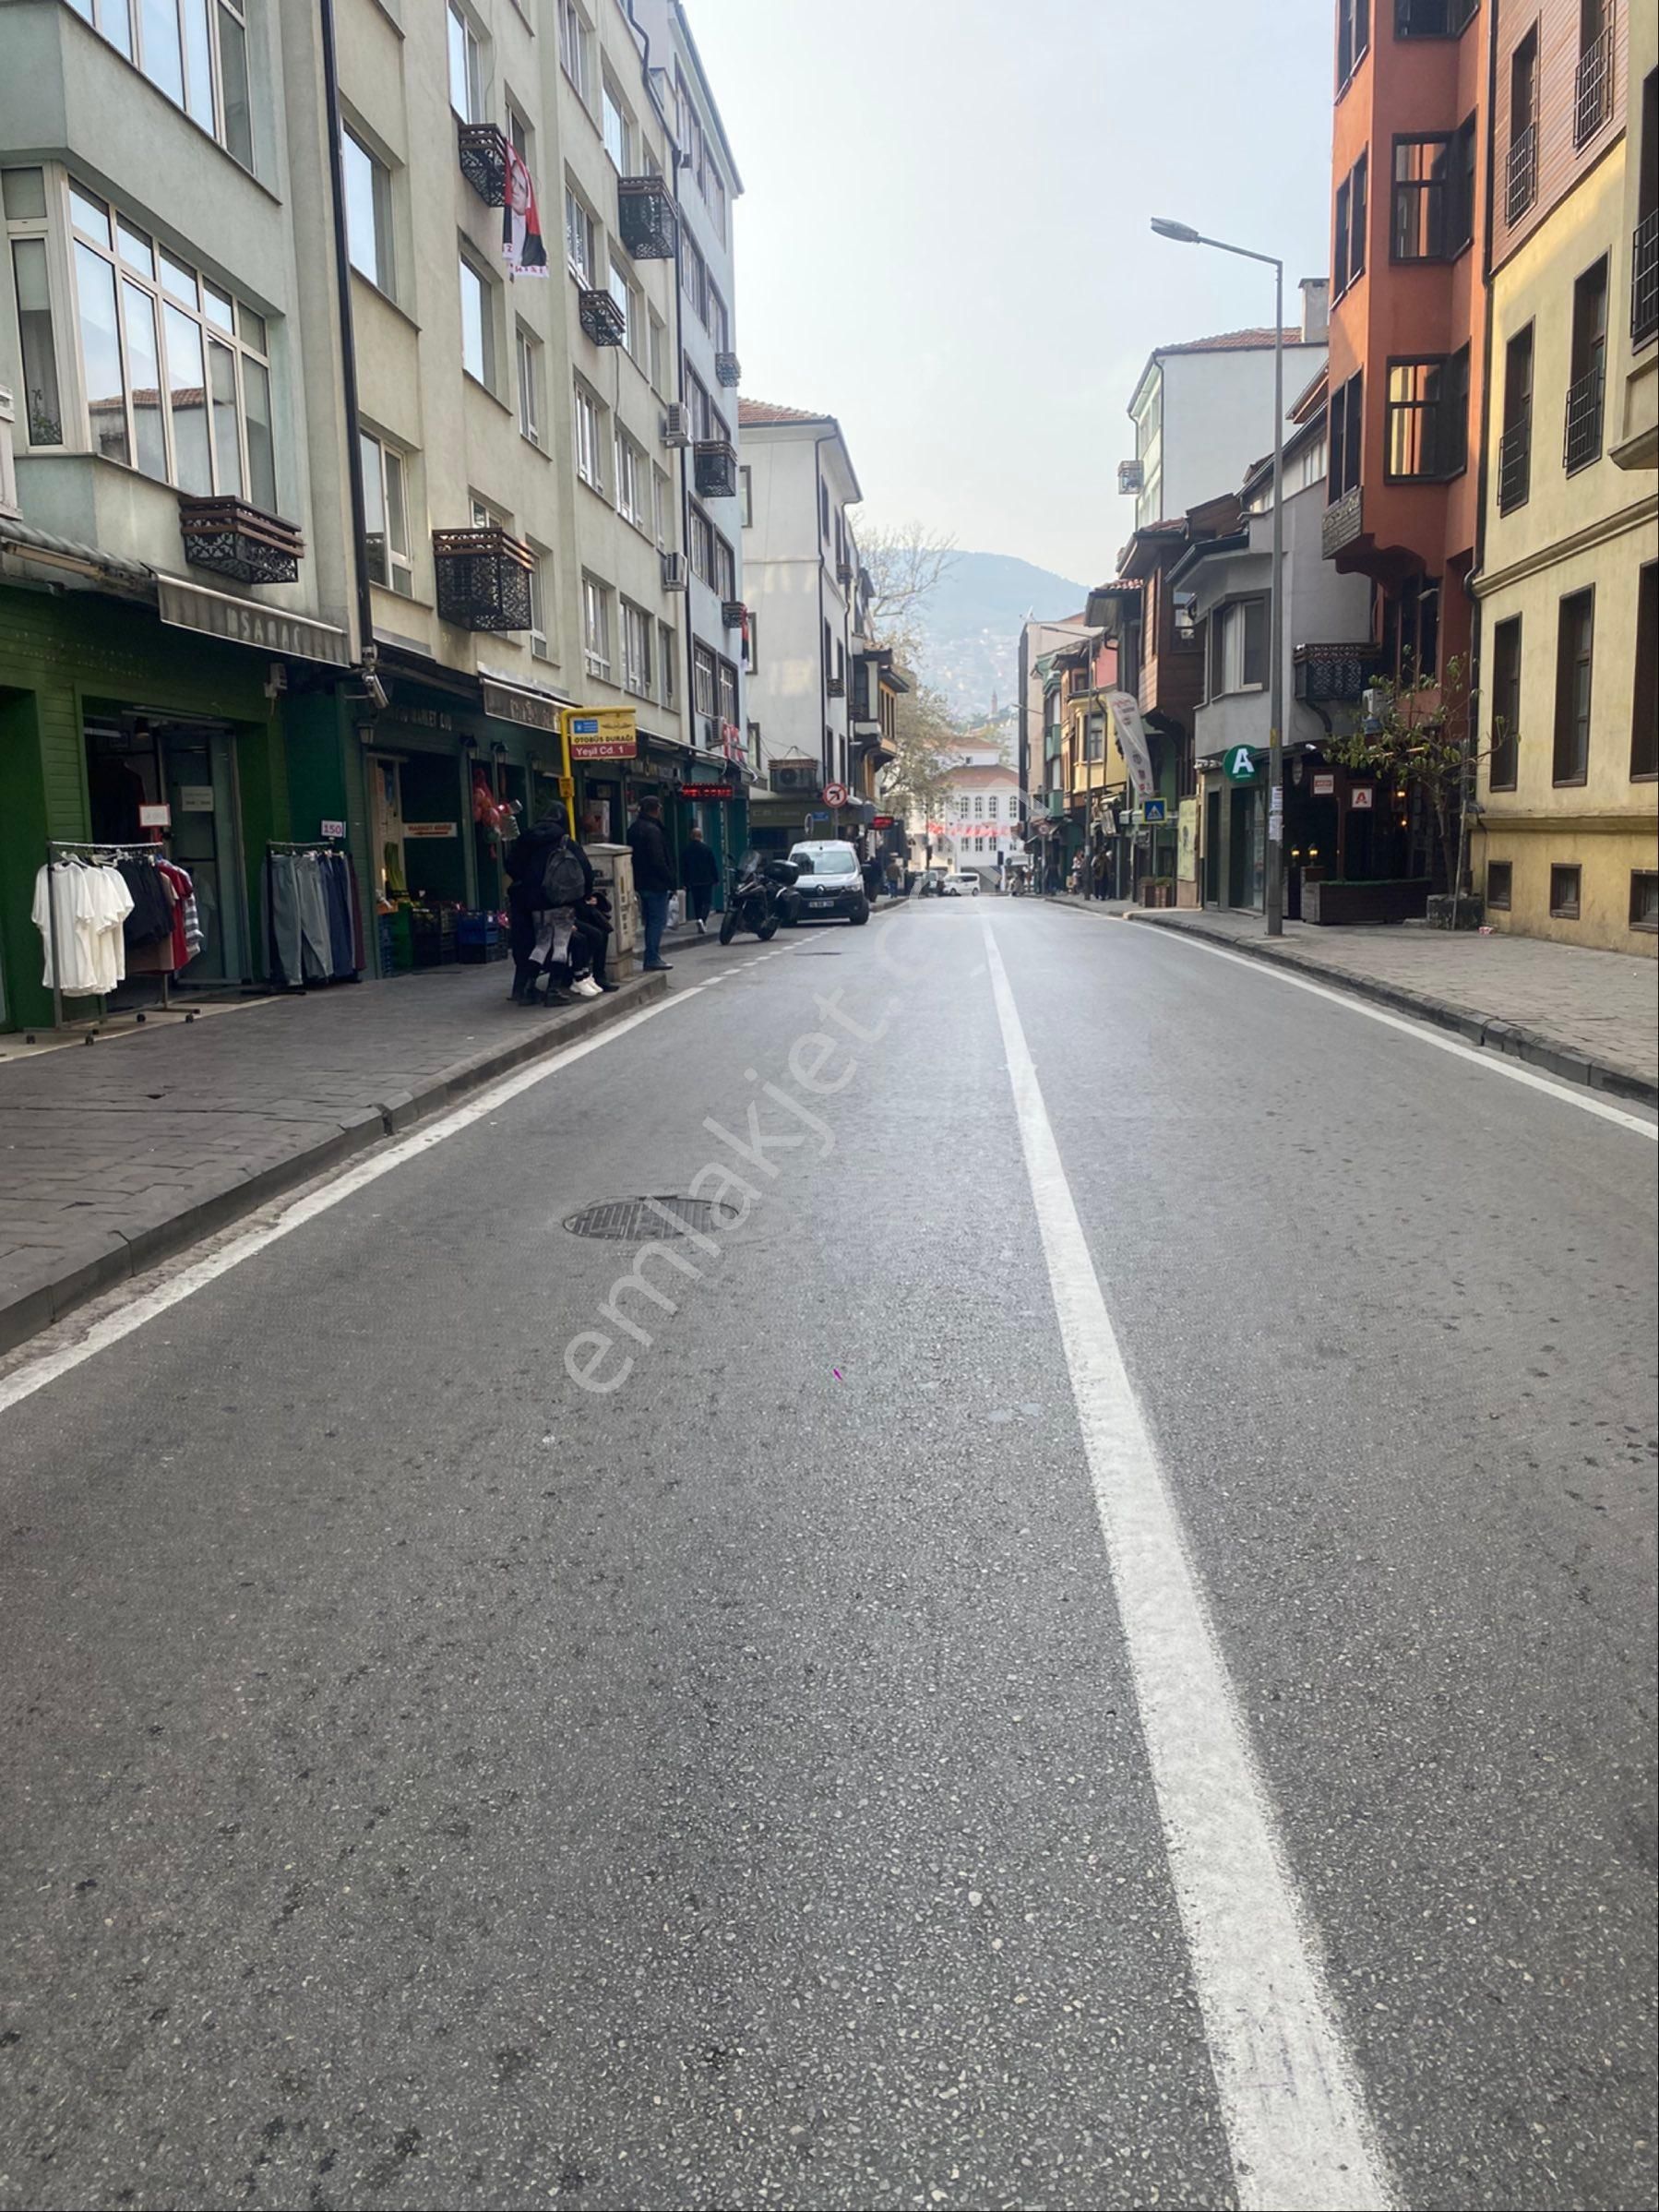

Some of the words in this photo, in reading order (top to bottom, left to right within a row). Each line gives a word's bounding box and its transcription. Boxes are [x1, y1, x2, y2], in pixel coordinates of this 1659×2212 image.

[574, 735, 604, 744] OTOBÜS
[576, 747, 598, 757] Yeşil
[618, 745, 625, 754] 1
[1232, 747, 1255, 774] A
[323, 824, 341, 835] 150
